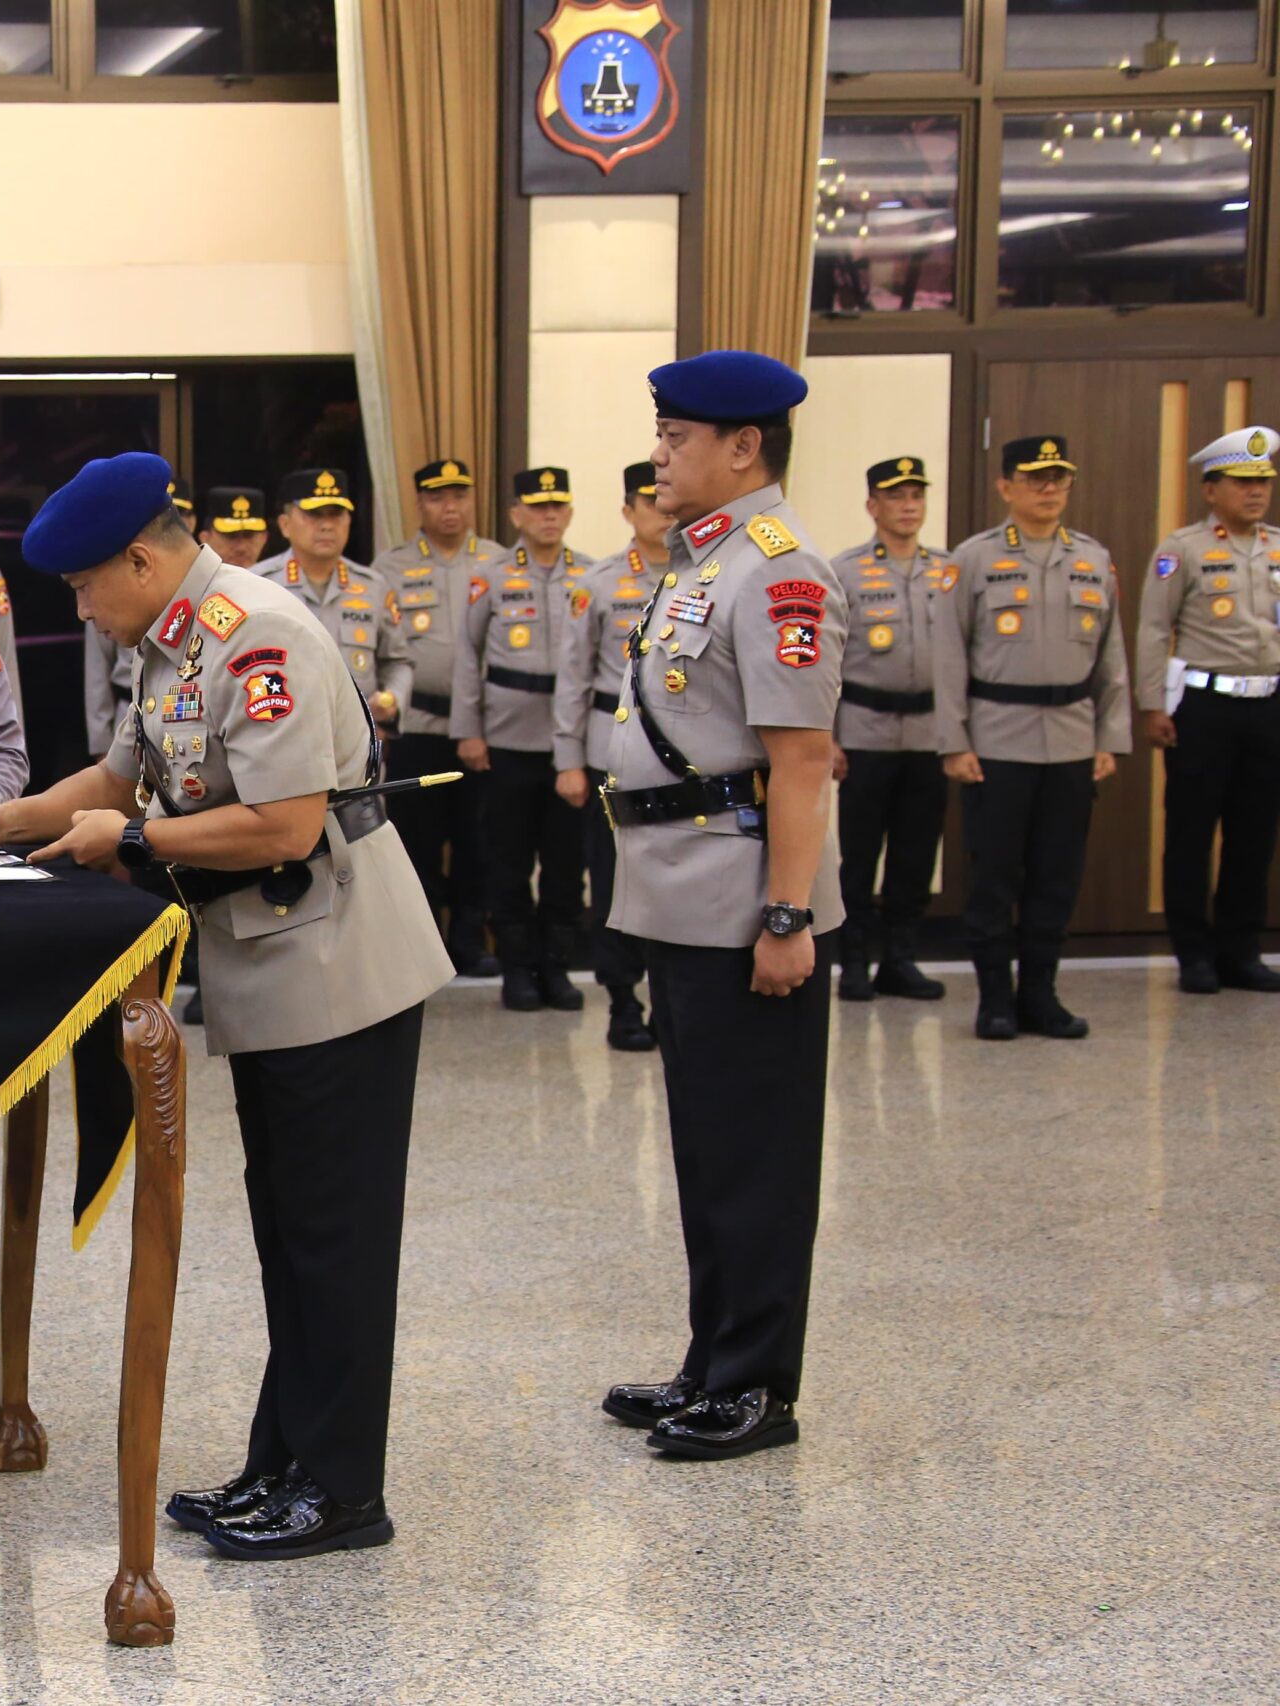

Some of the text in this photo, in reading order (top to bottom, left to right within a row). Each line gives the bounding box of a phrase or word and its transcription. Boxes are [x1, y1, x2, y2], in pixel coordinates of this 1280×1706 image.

[772, 583, 822, 598] PELOPOR
[248, 698, 290, 714] MABES POLRI
